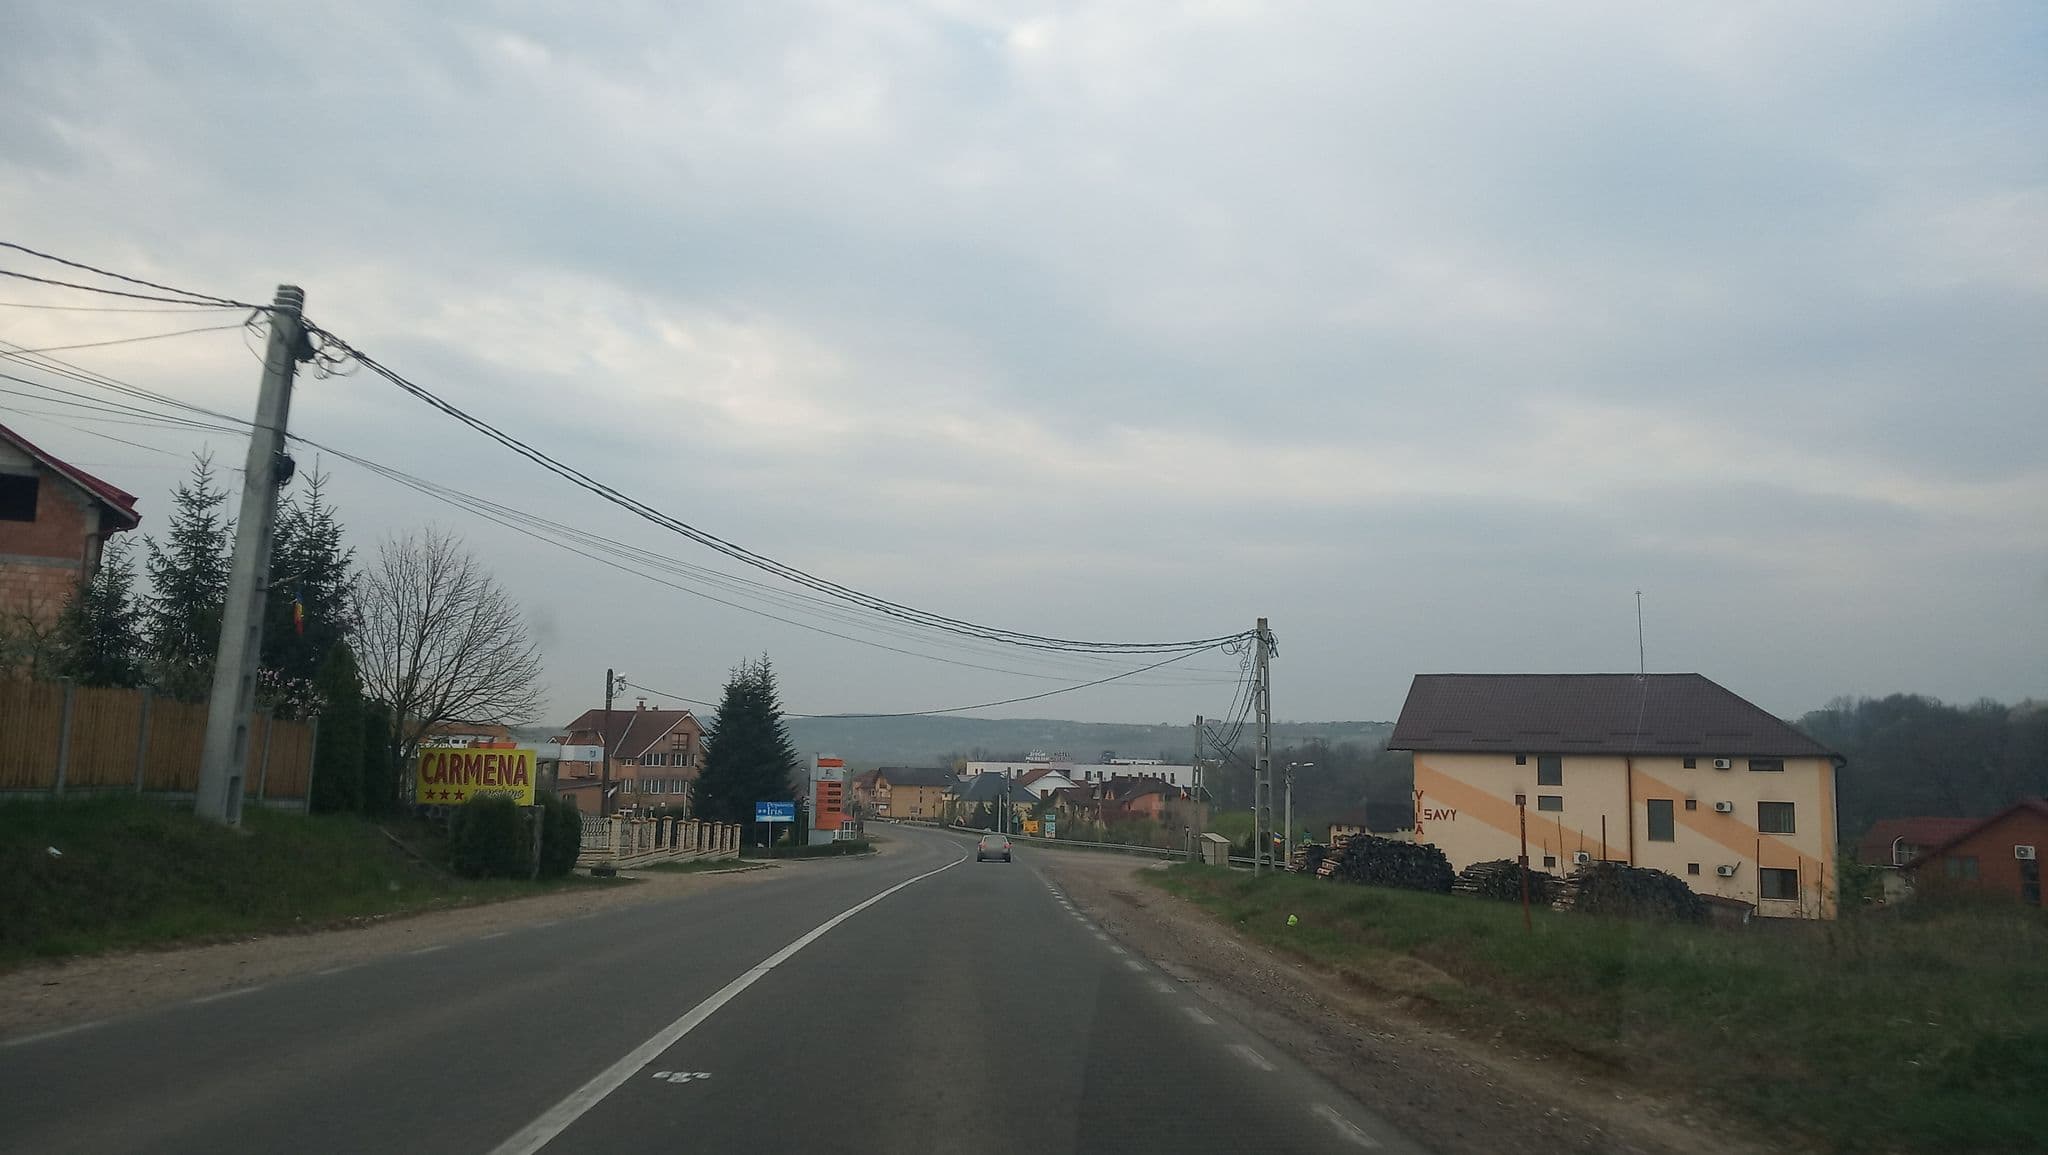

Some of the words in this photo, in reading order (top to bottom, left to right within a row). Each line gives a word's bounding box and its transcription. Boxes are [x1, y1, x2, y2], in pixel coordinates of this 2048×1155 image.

[421, 752, 529, 787] CARMENA
[767, 806, 784, 816] Iris
[1415, 789, 1424, 835] VILA
[1424, 808, 1457, 821] SAVY
